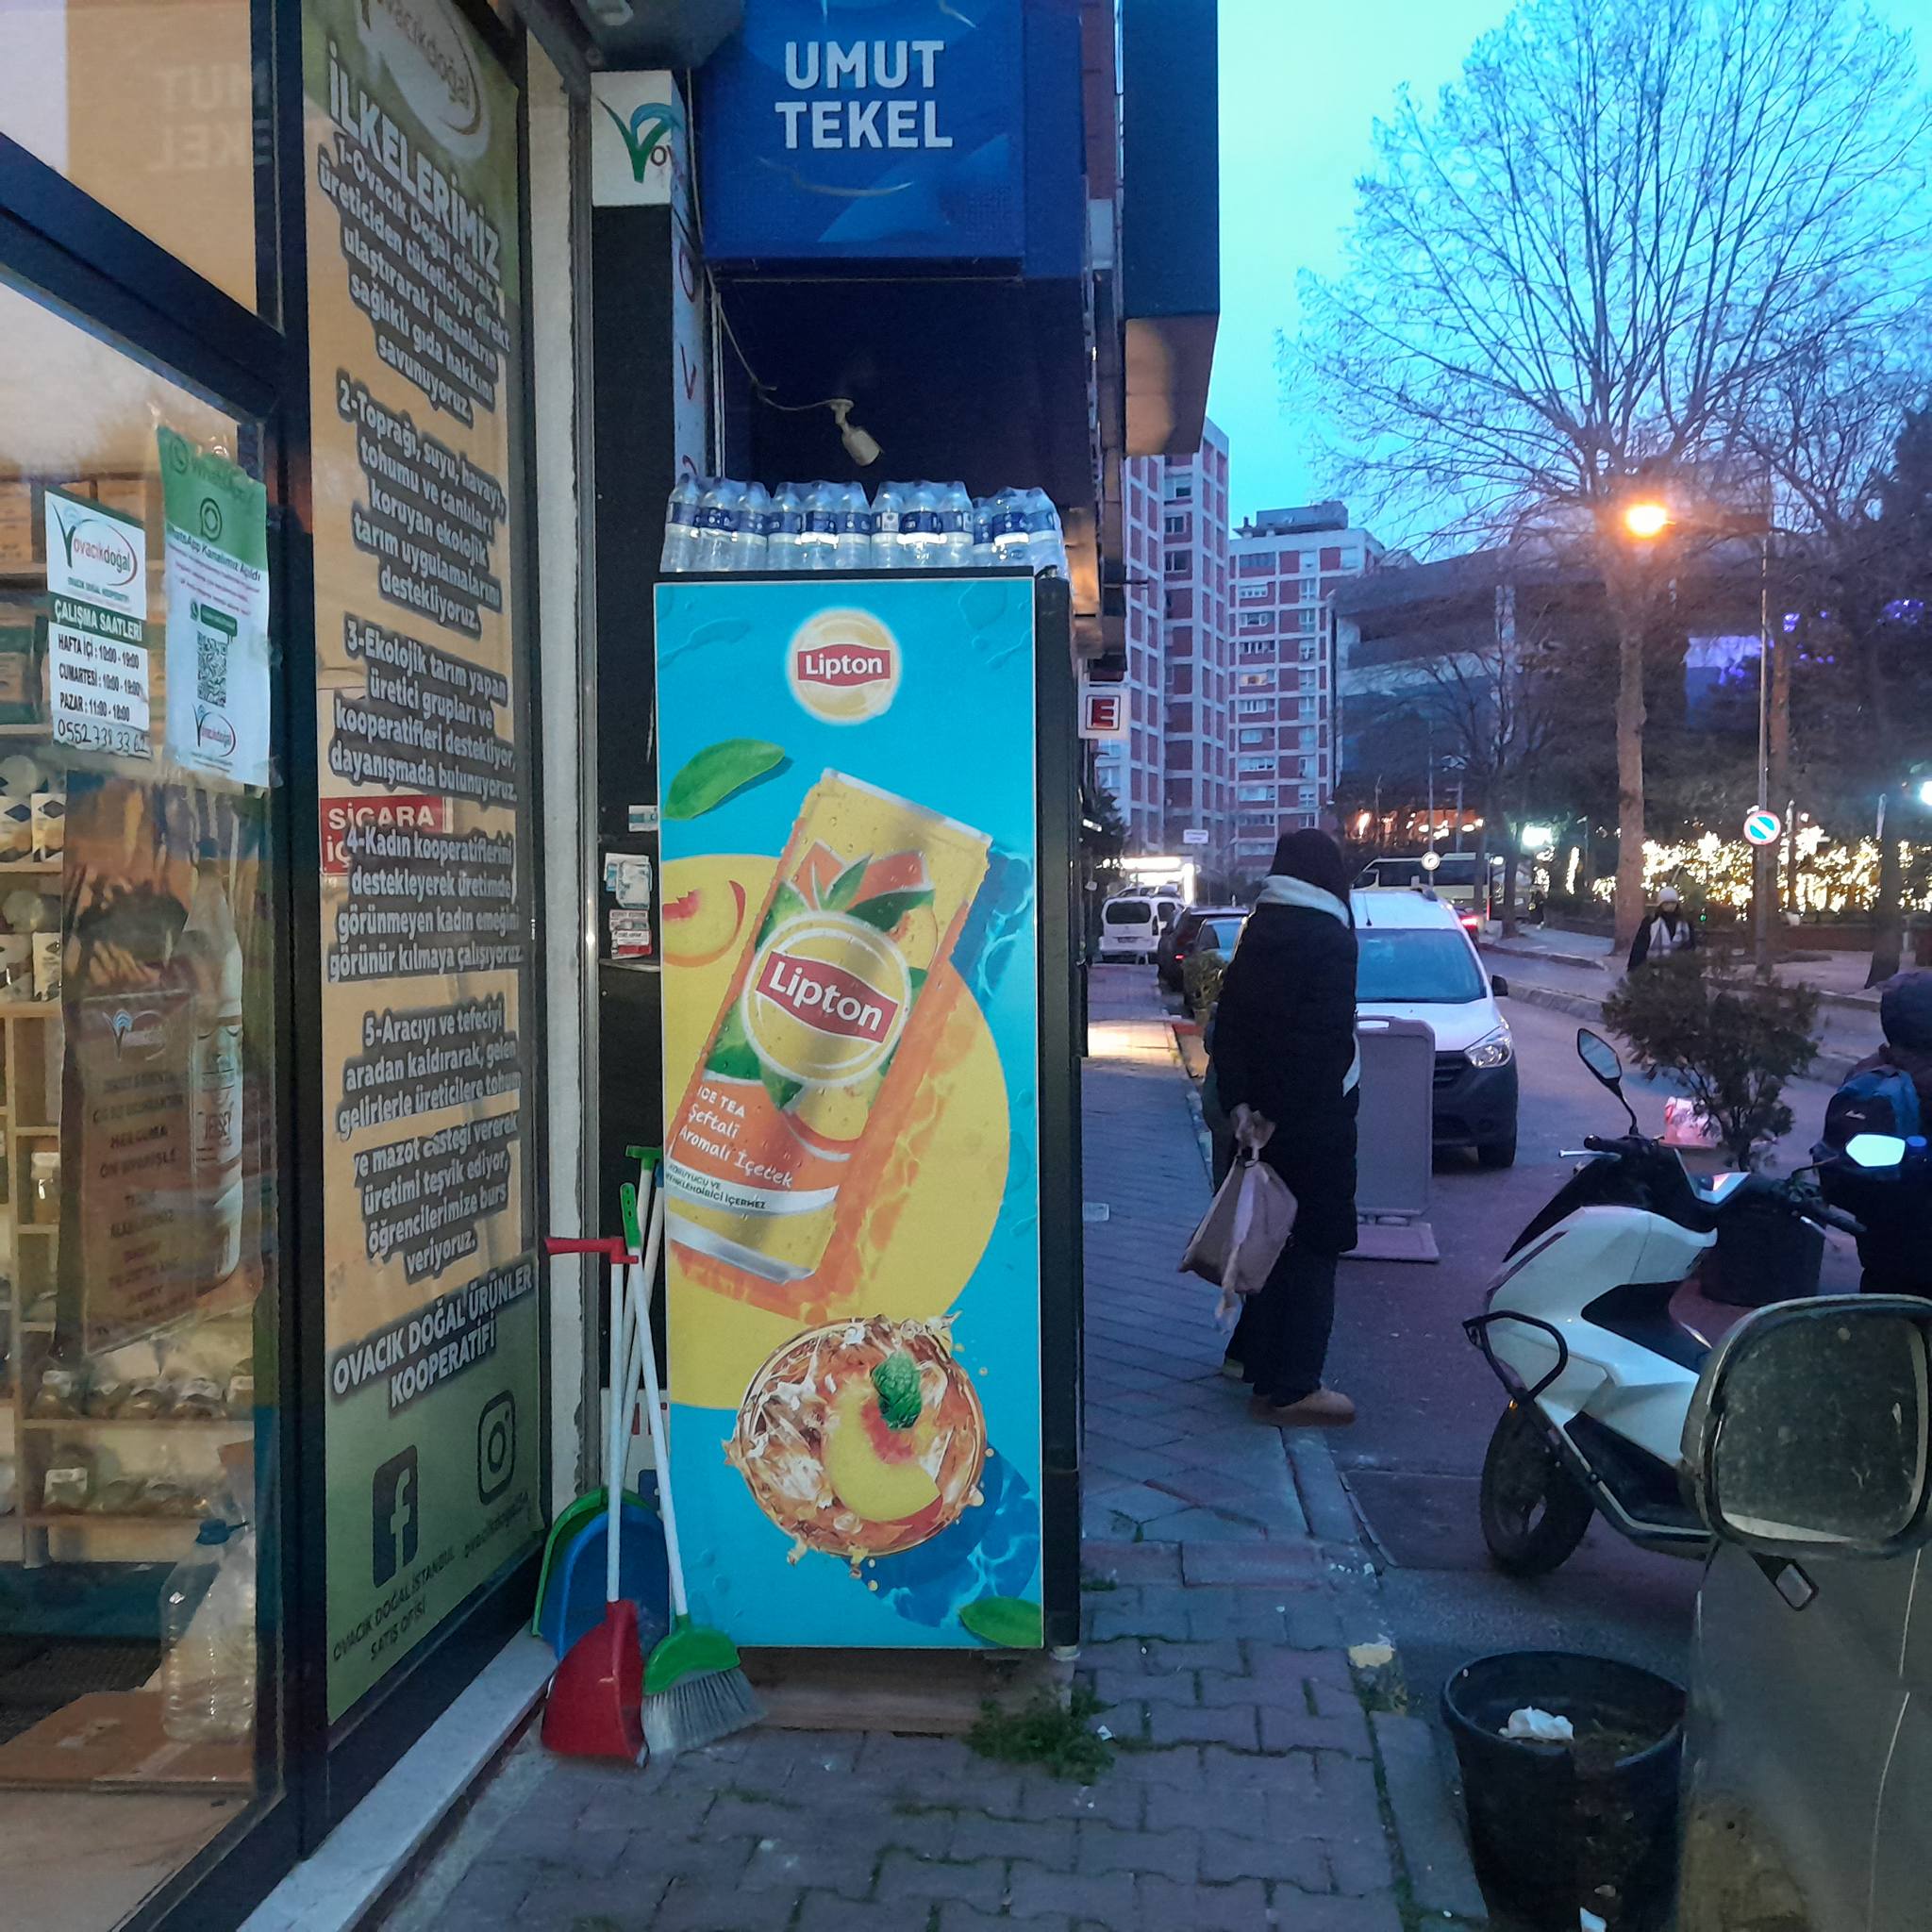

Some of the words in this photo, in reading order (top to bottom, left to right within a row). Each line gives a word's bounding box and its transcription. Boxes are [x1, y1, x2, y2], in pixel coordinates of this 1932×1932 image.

[786, 41, 946, 91] UMUT
[774, 100, 954, 149] TEKEL
[329, 41, 500, 281] İLKELERİMİZ
[321, 156, 403, 257] üreticiden
[406, 238, 473, 319] tüketiciye
[474, 306, 510, 353] direkt
[339, 137, 408, 223] 1-Ovacık
[410, 204, 451, 264] Doğal
[453, 251, 497, 310] olarak,
[344, 226, 431, 317] ulaştırarak
[433, 295, 498, 375] insanların
[350, 274, 409, 337] sağlıklı
[412, 324, 443, 364] gıda
[445, 342, 493, 403] hakkını
[378, 335, 472, 421] savunuyoruz.
[340, 379, 421, 462] 2-Toprağı,
[423, 441, 459, 487] suyu,
[461, 460, 507, 518] havayı,
[359, 436, 420, 494] tohumu
[422, 478, 439, 506] ve
[441, 491, 493, 537] canlıları
[371, 478, 433, 538] koruyan
[436, 520, 489, 567] ekolojik
[353, 511, 399, 558] tarım
[401, 540, 502, 605] uygulamalarını
[55, 599, 98, 629] ÇALIŞMA
[99, 613, 142, 641] SAATLERİ
[380, 565, 480, 630] destekliyoruz.
[58, 633, 83, 656] HAFTA
[58, 662, 98, 687] CUMARTESİ
[346, 620, 428, 677] 3-Ekolojik
[429, 653, 467, 688] tarım
[469, 668, 508, 701] yapan
[805, 653, 883, 679] Lipton
[59, 691, 84, 713] PAZAR
[370, 667, 419, 710] üretici
[422, 691, 476, 725] grupları
[477, 708, 493, 730] ve
[58, 718, 92, 744] 0552
[336, 698, 443, 752] kooperatifleri
[445, 736, 515, 773] destekliyor,
[330, 740, 436, 787] dayanışmada
[438, 761, 518, 802] bulunuyoruz.
[346, 824, 411, 858] 4-Kadın
[413, 830, 513, 867] kooperatiflerini
[352, 865, 456, 903] destekleyerek
[339, 904, 434, 944] görünmeyen
[436, 905, 474, 933] kadın
[475, 905, 520, 938] emeğini
[329, 942, 396, 982] görünür
[398, 942, 455, 974] kılmaya
[364, 1015, 436, 1047] 5-Aracıyı
[439, 1015, 455, 1036] ve
[457, 1002, 503, 1036] tefeciyi
[768, 960, 883, 1032] Lipton
[346, 1055, 404, 1092] aradan
[408, 1046, 484, 1080] kaldırarak,
[486, 1039, 517, 1068] gelen
[339, 1092, 412, 1141] gelirlerle
[416, 1074, 484, 1114] üreticilere
[486, 1071, 522, 1096] tohum
[689, 1103, 741, 1140] Şeftali
[698, 1086, 717, 1103] ICE
[721, 1096, 745, 1118] TEA
[373, 1137, 420, 1174] mazot
[474, 1112, 518, 1142] vererek
[679, 1124, 732, 1162] Aromalı
[734, 1148, 792, 1189] İçecek
[363, 1169, 421, 1216] üretimi
[423, 1157, 465, 1195] teşvik
[467, 1148, 508, 1180] ediyor,
[368, 1190, 477, 1255] öğrencilerimize
[479, 1182, 508, 1208] burs
[407, 1227, 475, 1274] veriyoruz.
[333, 1326, 405, 1394] OVACIK
[408, 1297, 466, 1355] DOĞAL
[468, 1264, 533, 1321] ÜRÜNLER
[391, 1311, 496, 1408] KOOPERATİFİ
